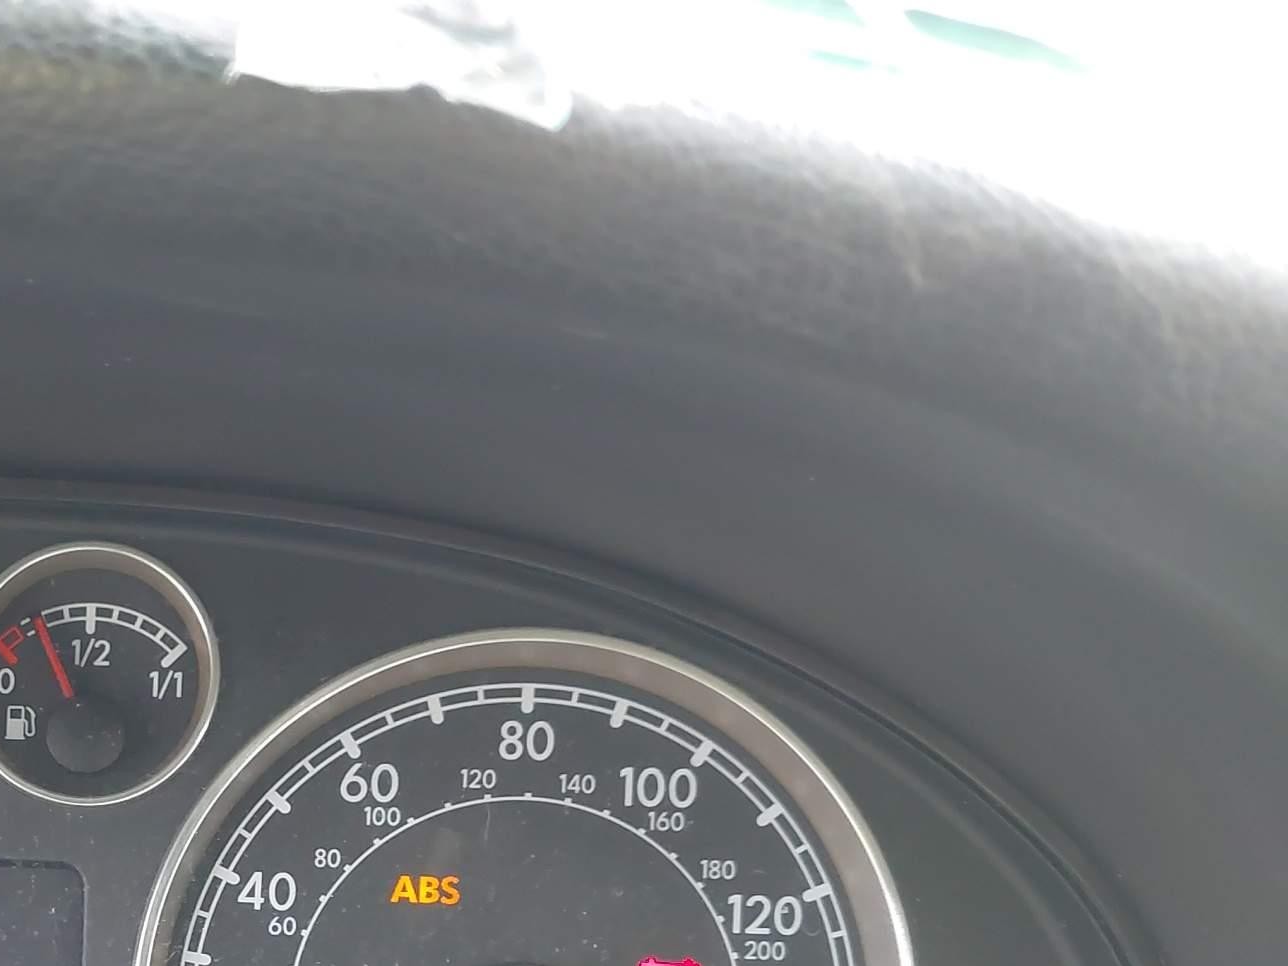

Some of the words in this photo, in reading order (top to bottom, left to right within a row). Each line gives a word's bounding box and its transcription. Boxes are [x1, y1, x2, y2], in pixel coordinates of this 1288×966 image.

[72, 639, 111, 667] 1/2
[150, 671, 183, 700] 1/1
[499, 721, 555, 761] 80
[340, 764, 400, 802] 60
[460, 769, 497, 789] 120
[559, 774, 596, 795] 140
[619, 767, 698, 808] 100
[364, 807, 401, 827] 100
[648, 812, 685, 832] 160
[314, 848, 342, 869] 80
[700, 860, 737, 880] 180
[238, 872, 296, 911] 40
[390, 876, 461, 905] ABS
[268, 916, 297, 936] 60
[728, 895, 802, 935] 120
[745, 942, 786, 962] 200
